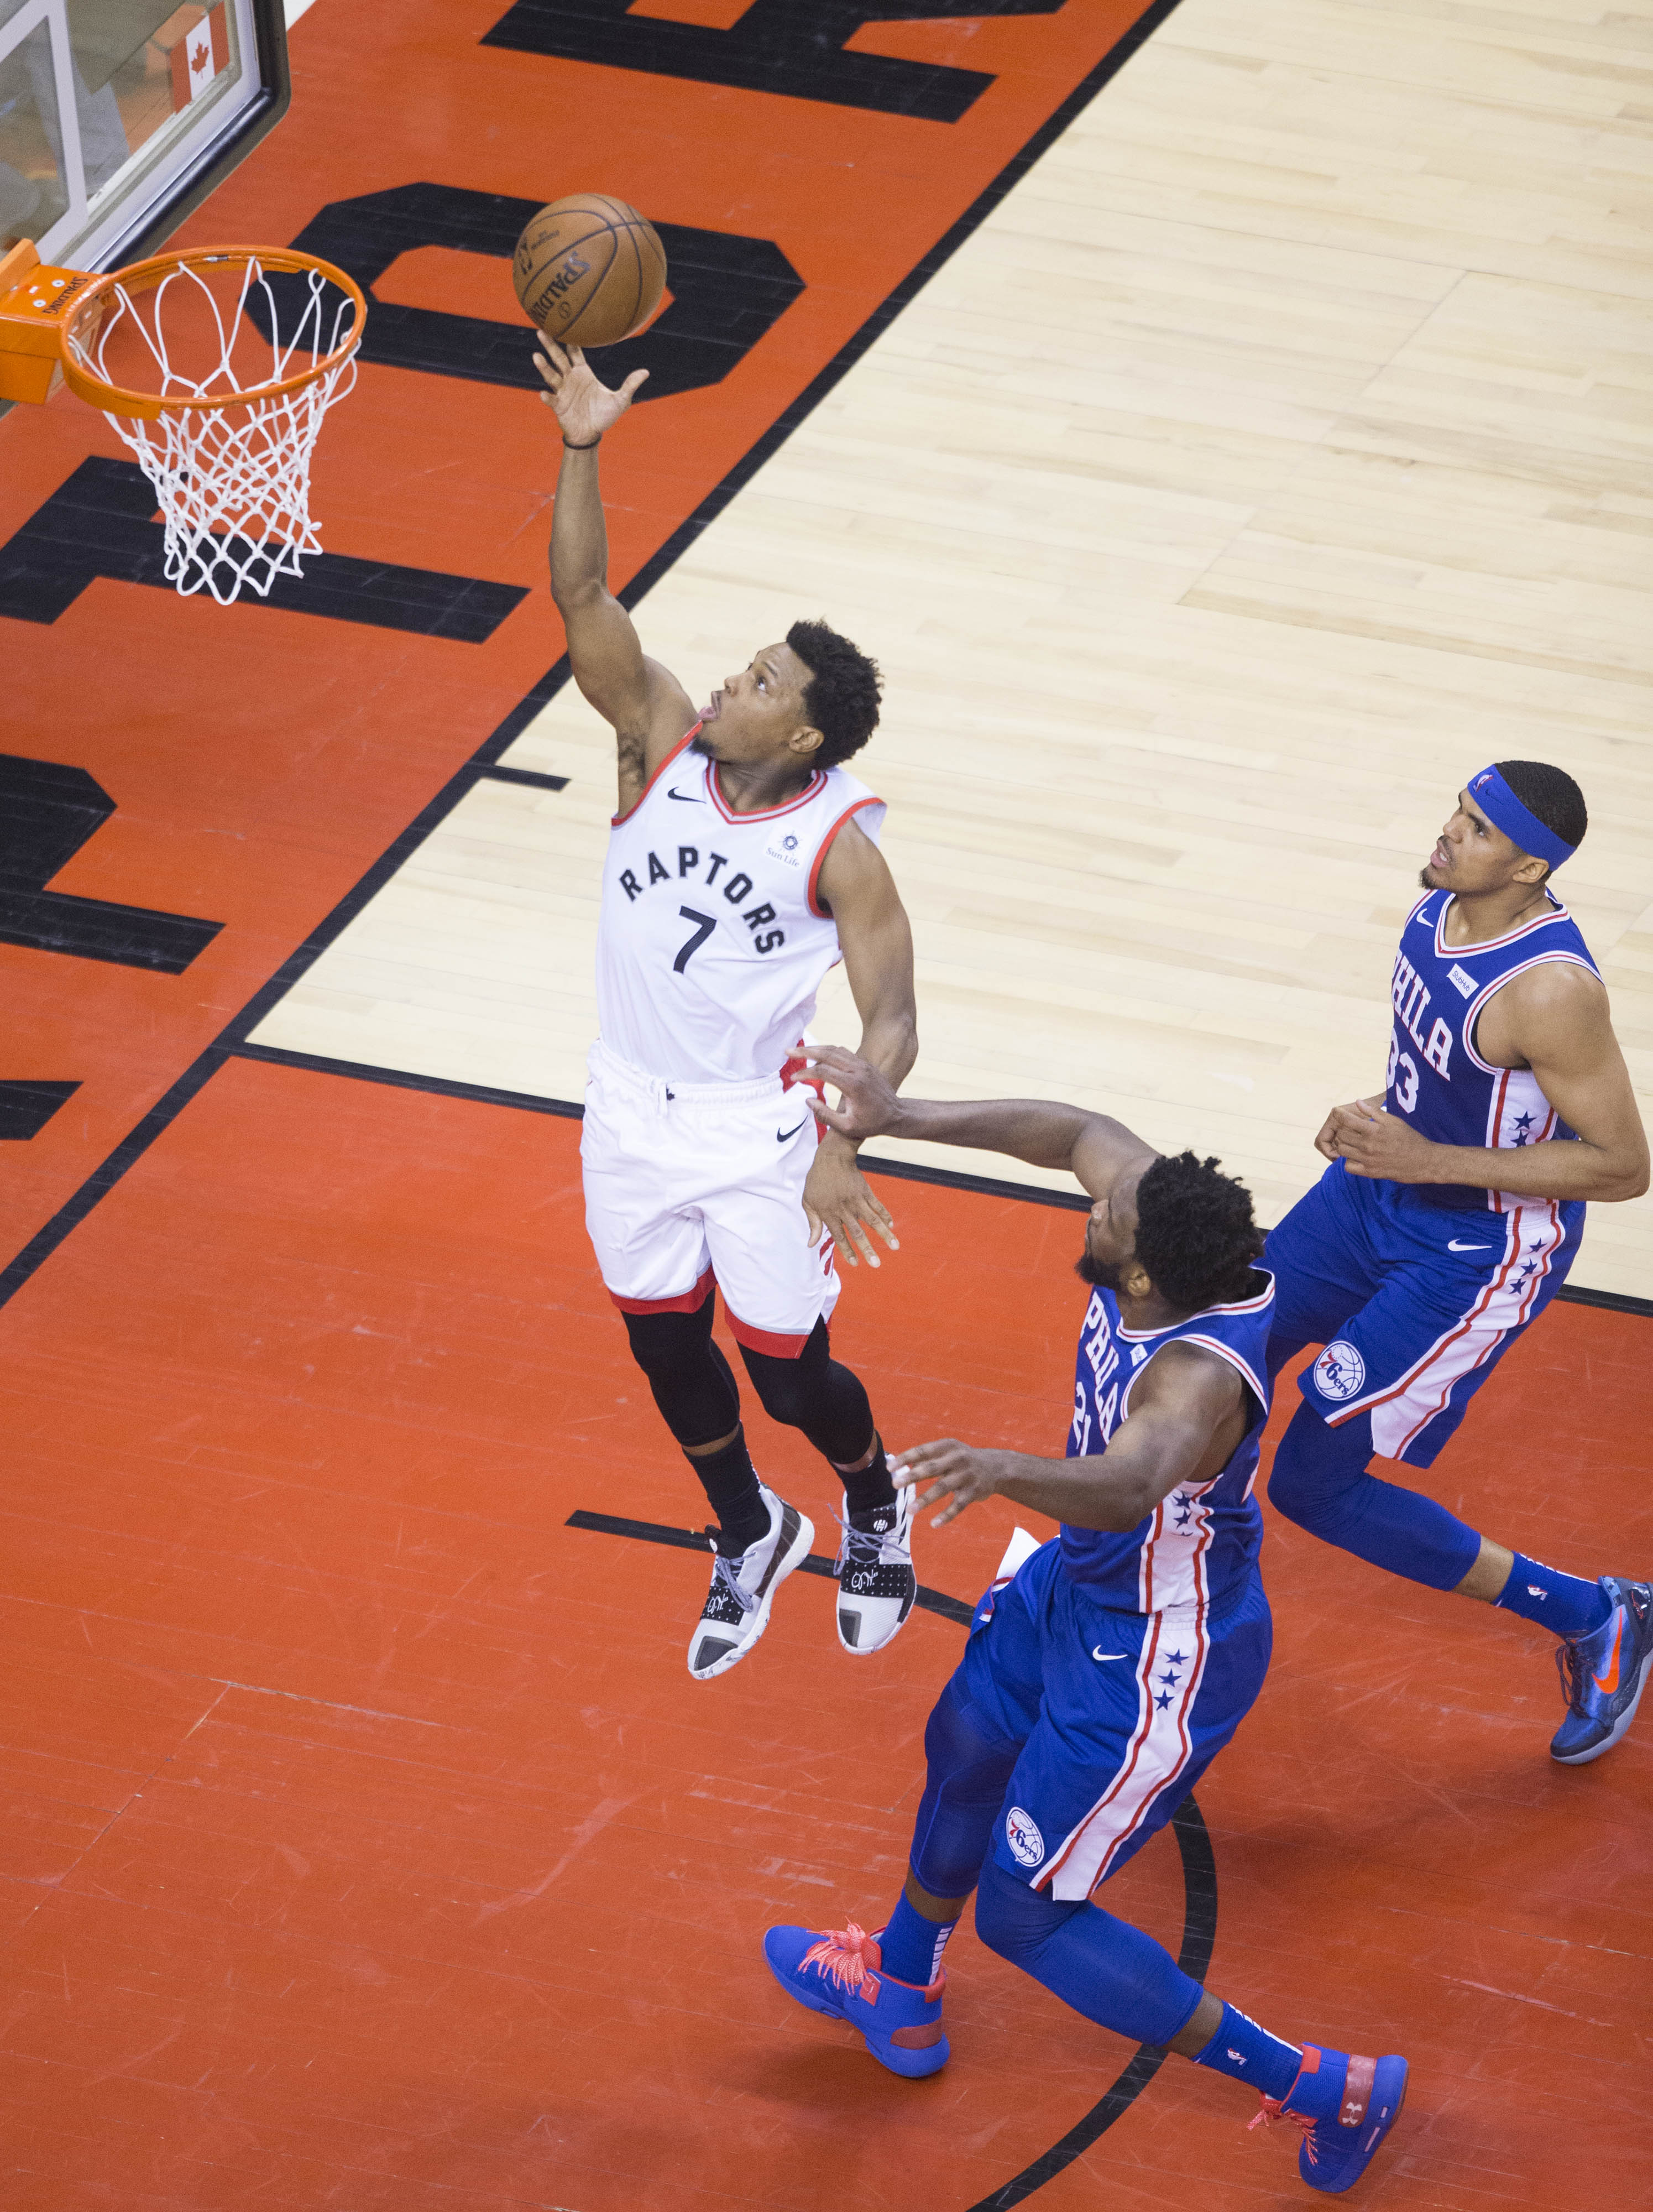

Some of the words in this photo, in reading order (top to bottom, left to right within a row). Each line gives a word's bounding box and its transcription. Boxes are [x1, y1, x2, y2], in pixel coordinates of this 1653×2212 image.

[41, 276, 88, 314] SPALDING
[766, 847, 782, 860] Sun
[784, 854, 799, 867] Life
[619, 846, 786, 955] RAPTORS
[673, 905, 718, 975] 7
[1452, 970, 1471, 992] StubHub
